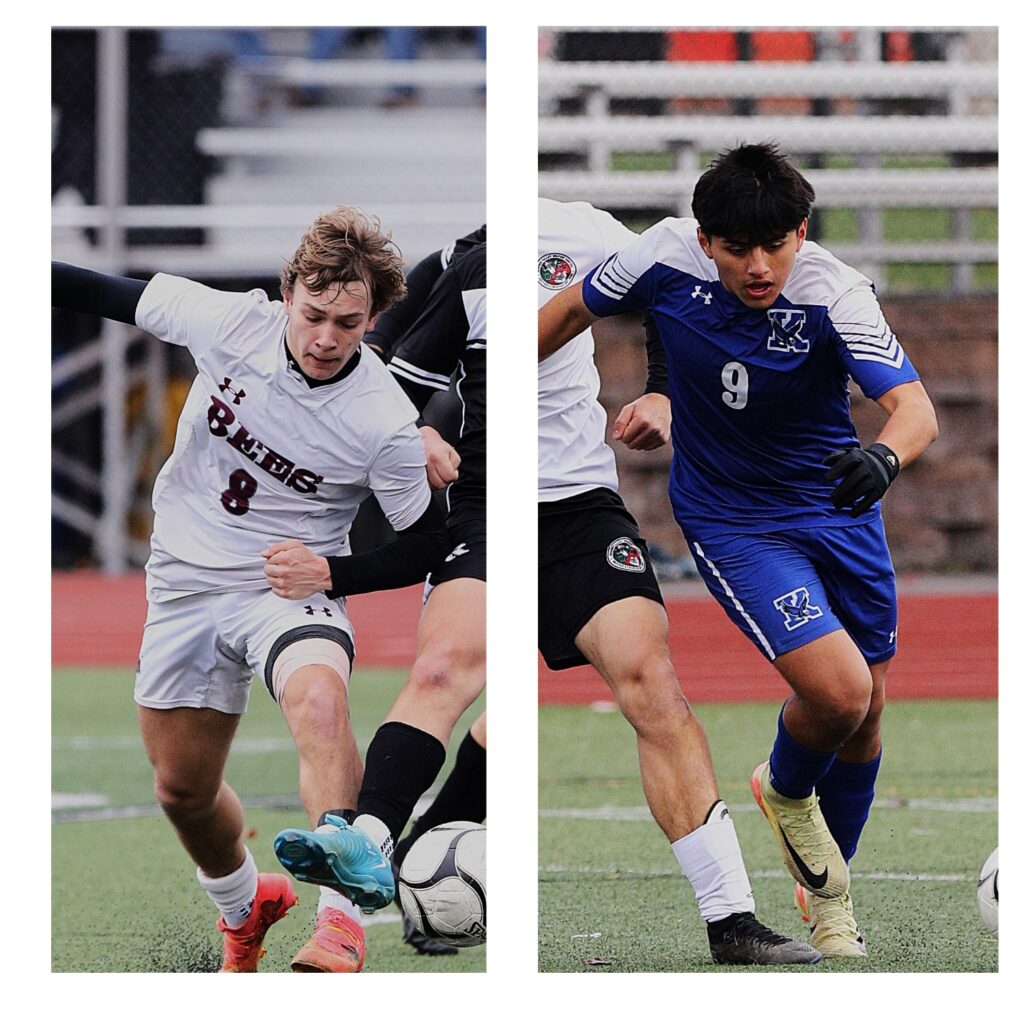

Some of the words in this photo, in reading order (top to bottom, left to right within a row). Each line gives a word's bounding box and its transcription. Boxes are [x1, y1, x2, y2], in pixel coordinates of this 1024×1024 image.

[721, 361, 749, 410] 9
[207, 395, 325, 494] BEES
[220, 468, 258, 516] 8
